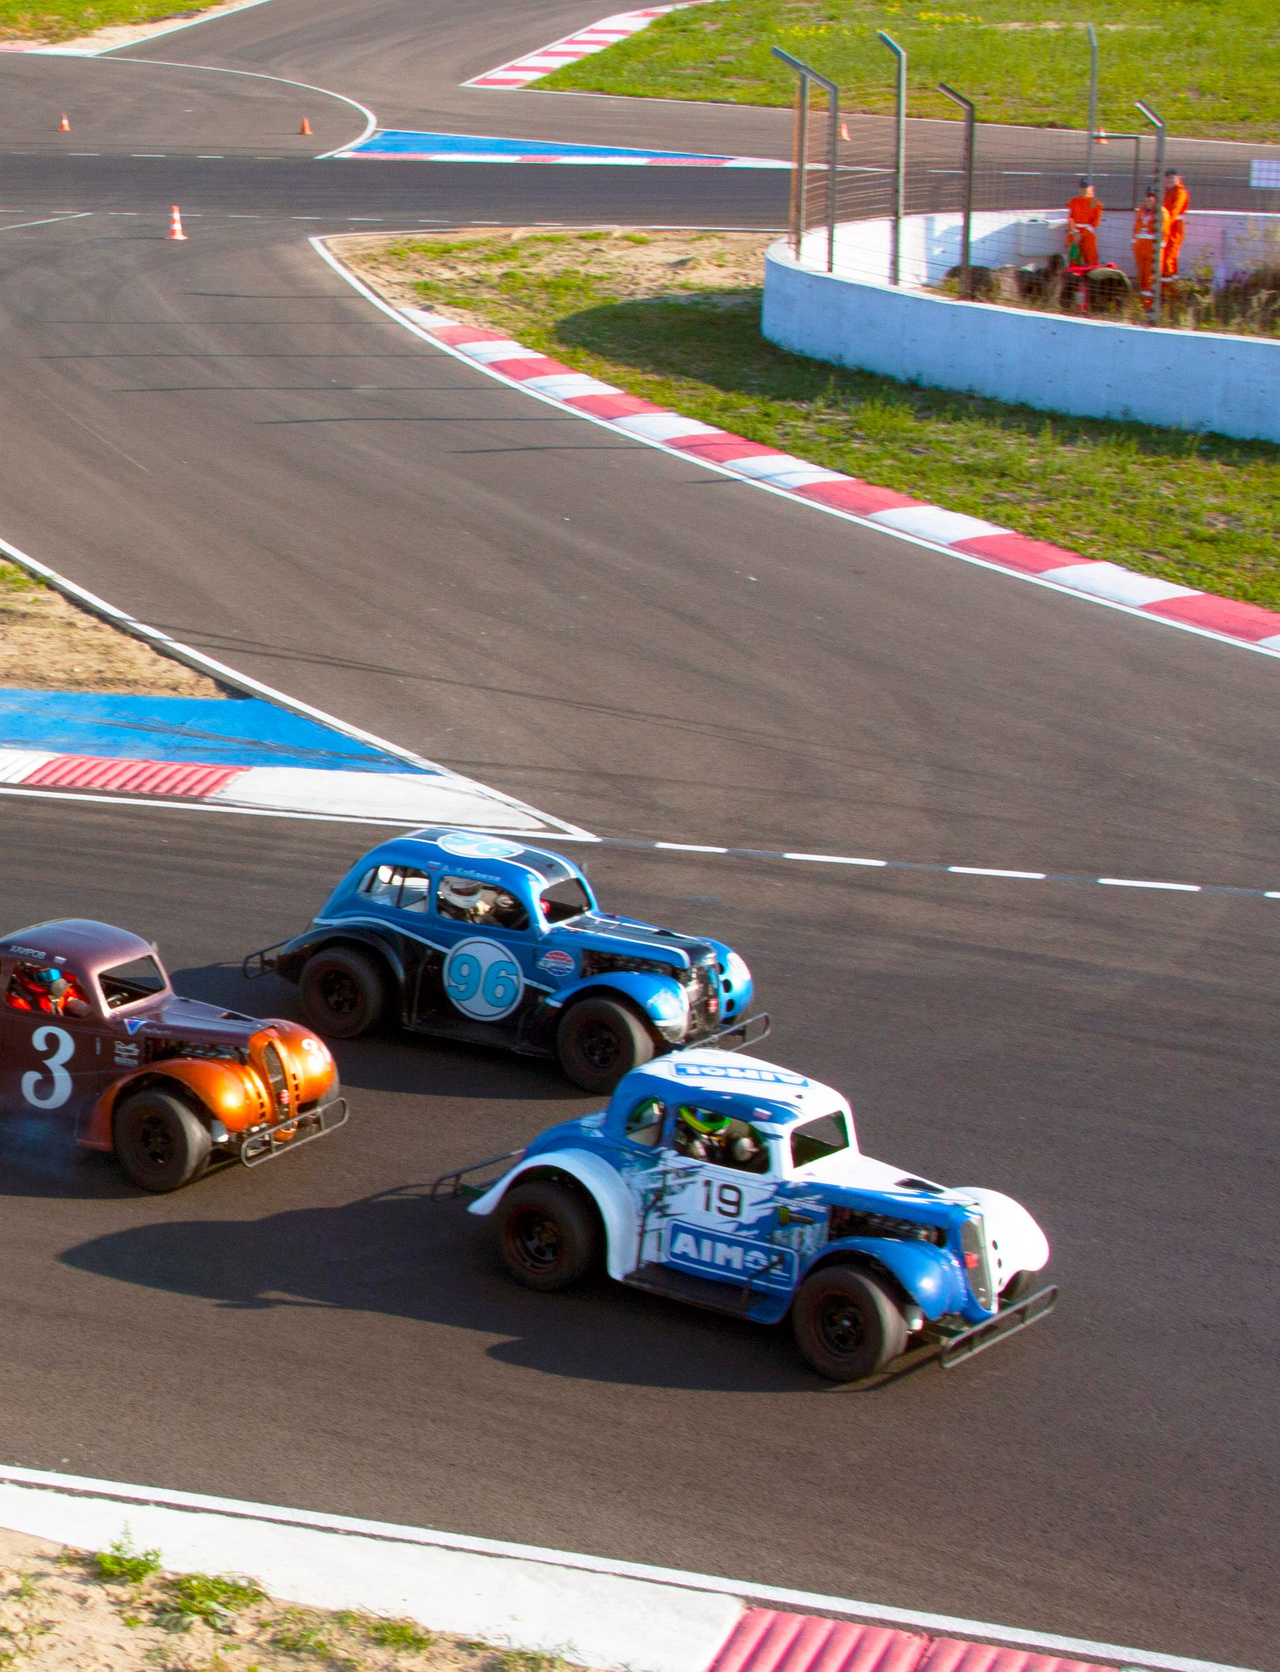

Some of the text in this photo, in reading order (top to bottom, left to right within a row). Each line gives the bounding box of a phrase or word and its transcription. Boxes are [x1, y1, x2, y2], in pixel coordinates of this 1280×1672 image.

[446, 953, 519, 1008] 96
[21, 1025, 76, 1109] 3
[677, 1064, 808, 1085] AIMOL
[703, 1179, 743, 1218] 19
